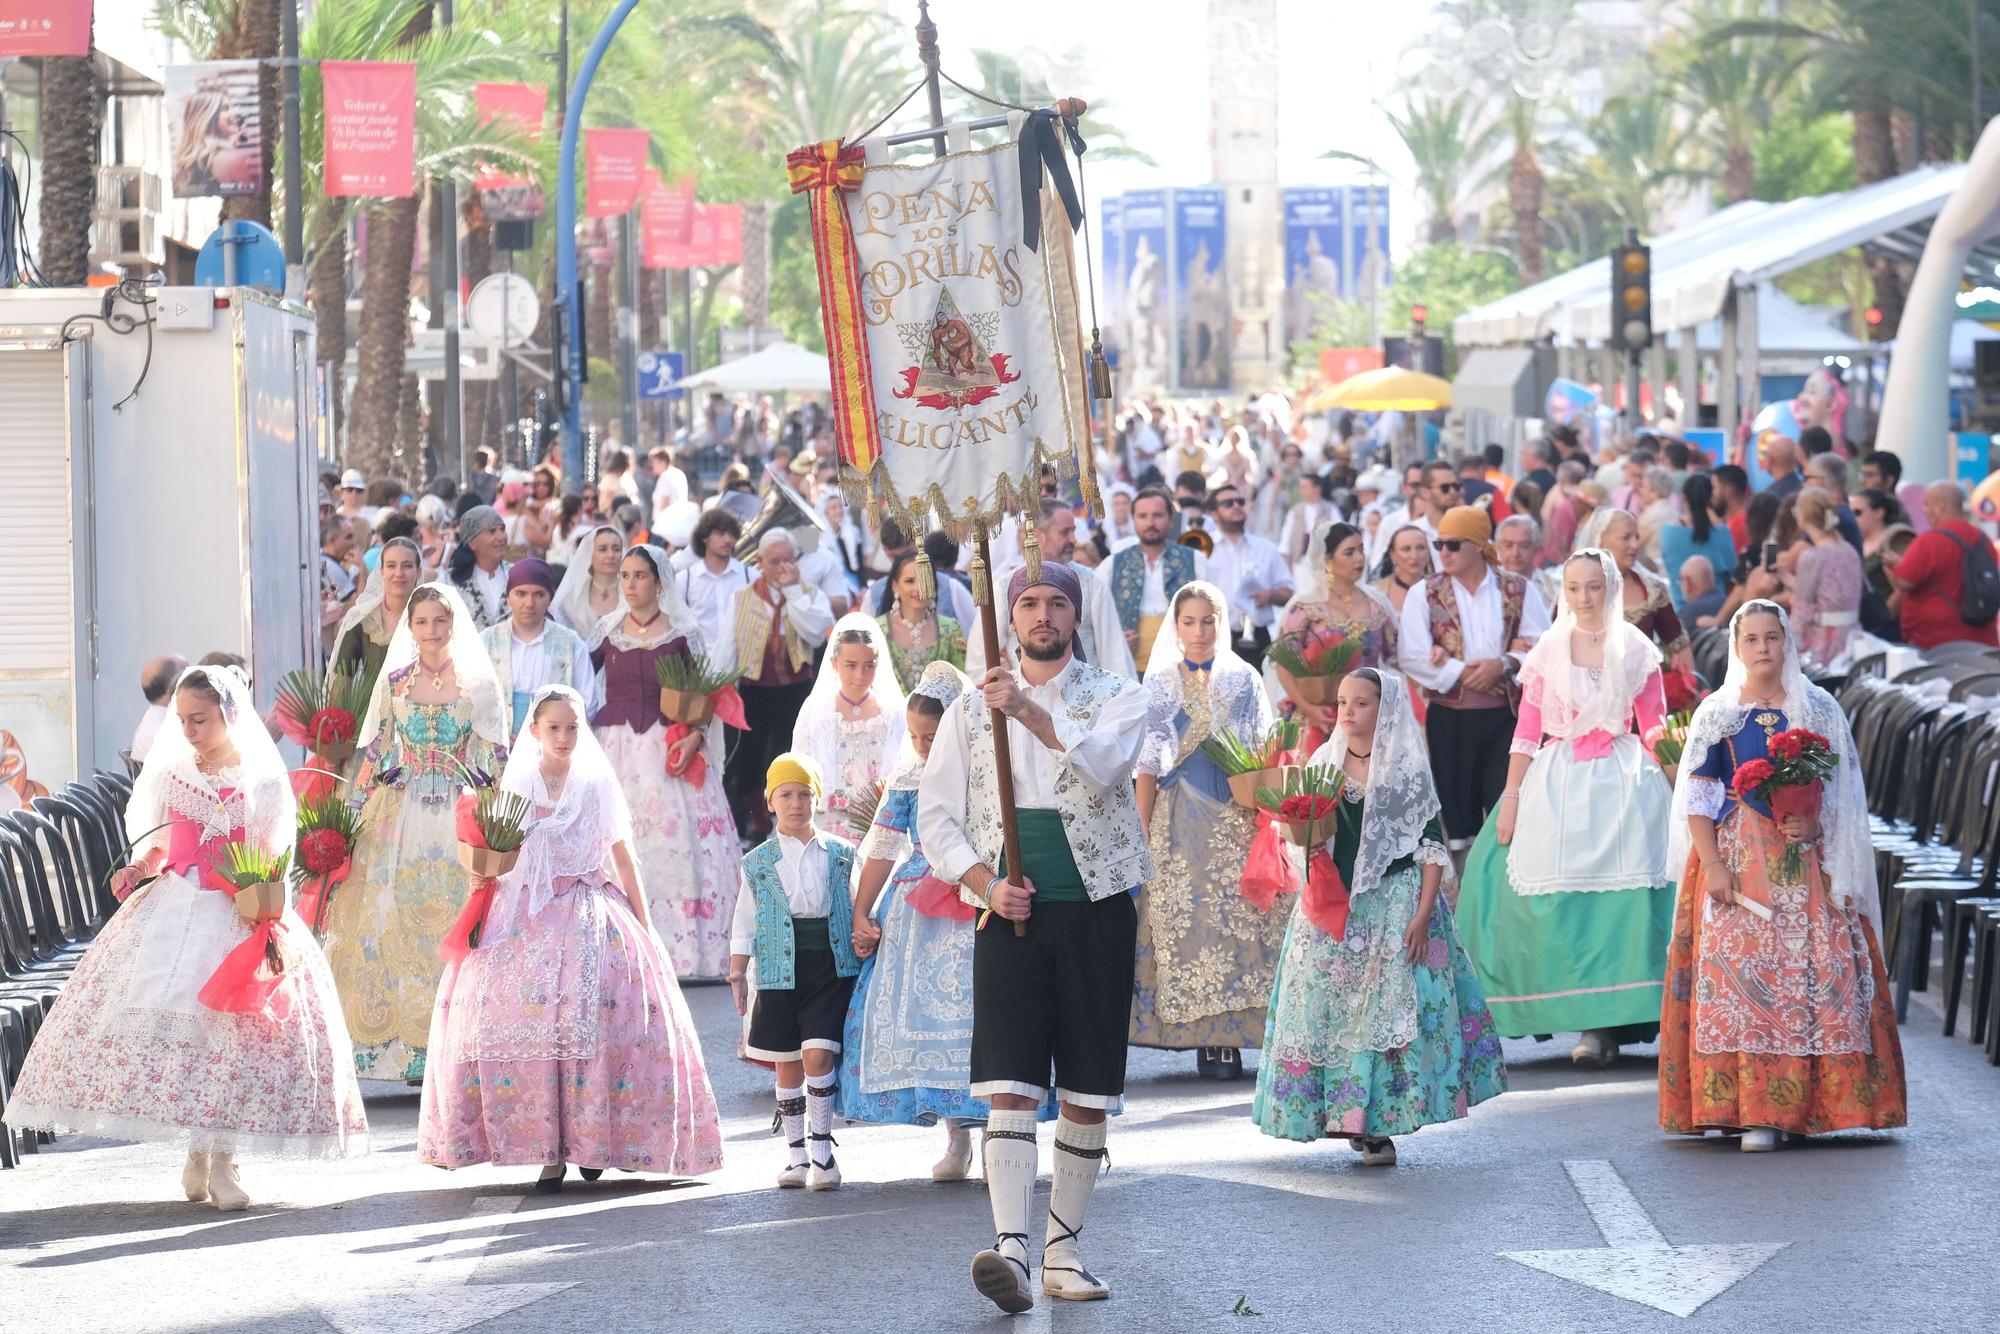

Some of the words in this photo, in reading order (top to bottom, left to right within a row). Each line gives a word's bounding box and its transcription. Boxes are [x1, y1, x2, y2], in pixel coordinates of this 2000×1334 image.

[343, 99, 377, 112] Volver
[856, 177, 1000, 239] PEÑA
[911, 224, 958, 243] LOS
[860, 242, 1024, 326] GORILAS
[878, 385, 1039, 450] ALICANTE
